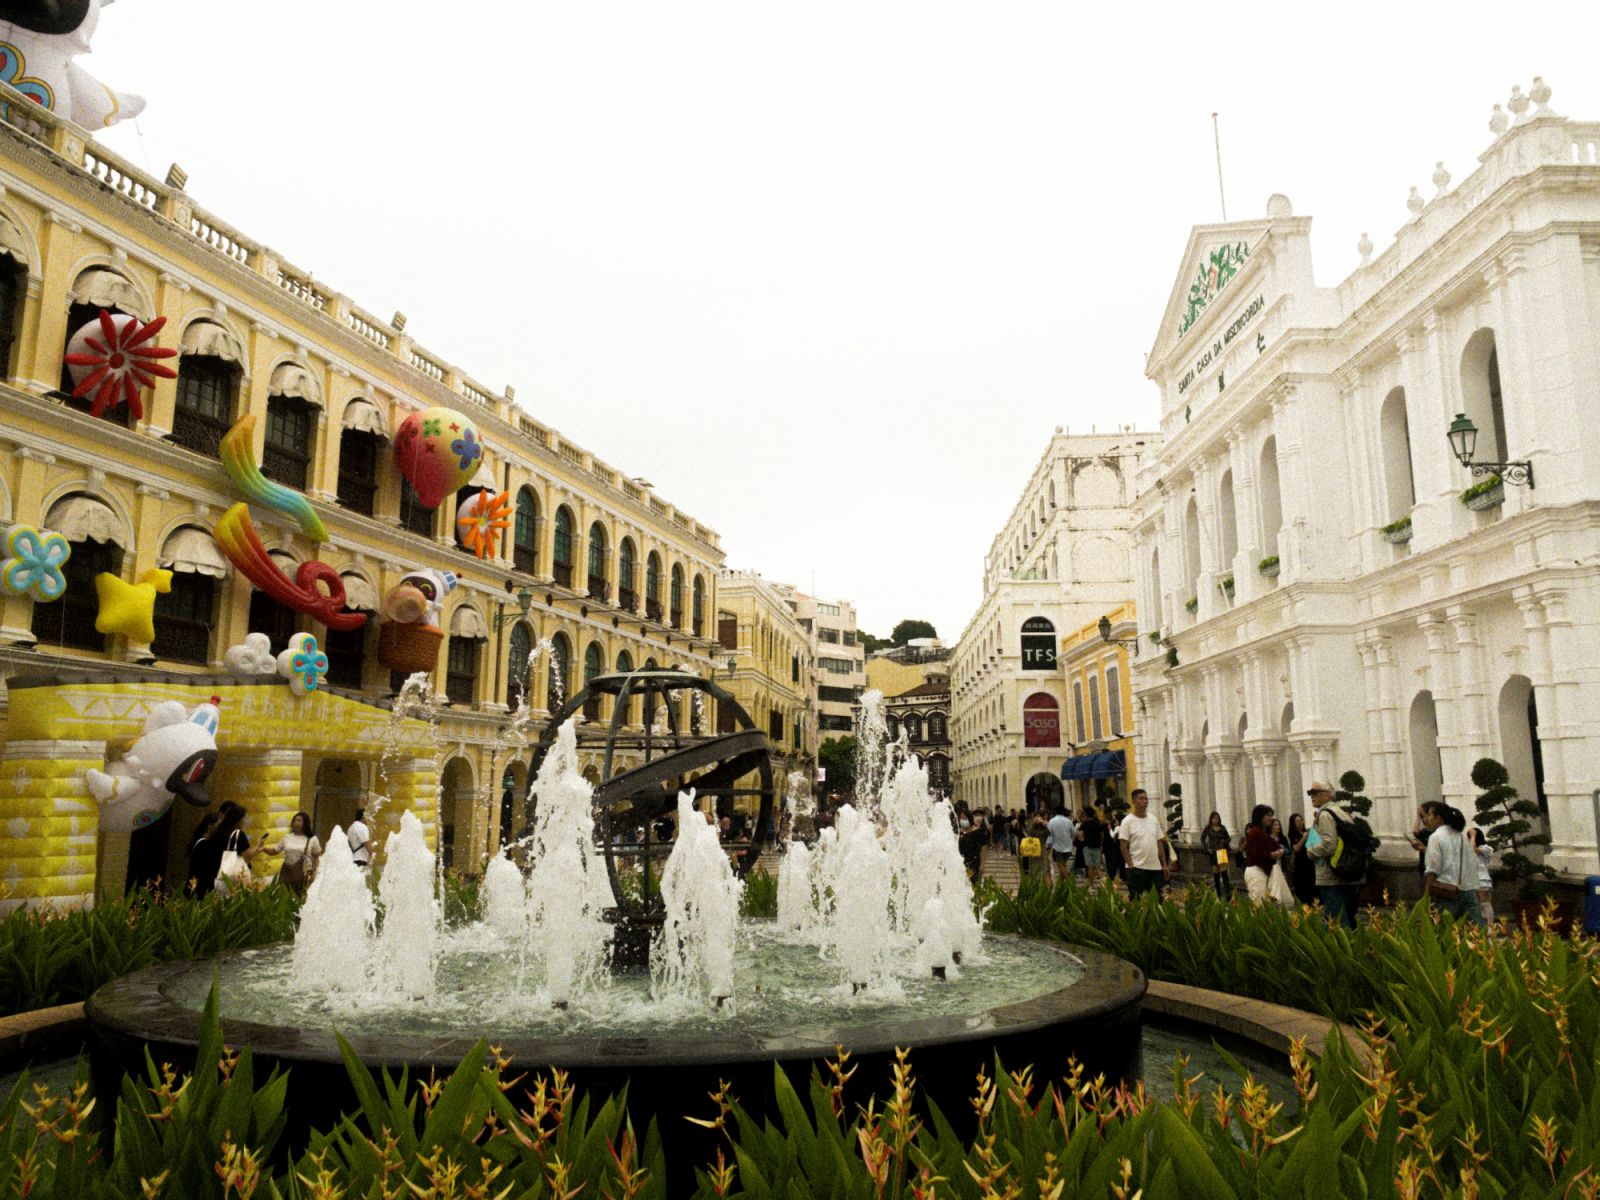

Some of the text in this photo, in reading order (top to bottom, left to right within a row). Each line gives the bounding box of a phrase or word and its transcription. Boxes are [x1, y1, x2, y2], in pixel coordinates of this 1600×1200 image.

[1178, 369, 1195, 394] SANTA
[1196, 350, 1213, 374] CASA
[1214, 340, 1223, 356] DA
[1024, 648, 1054, 662] TFS
